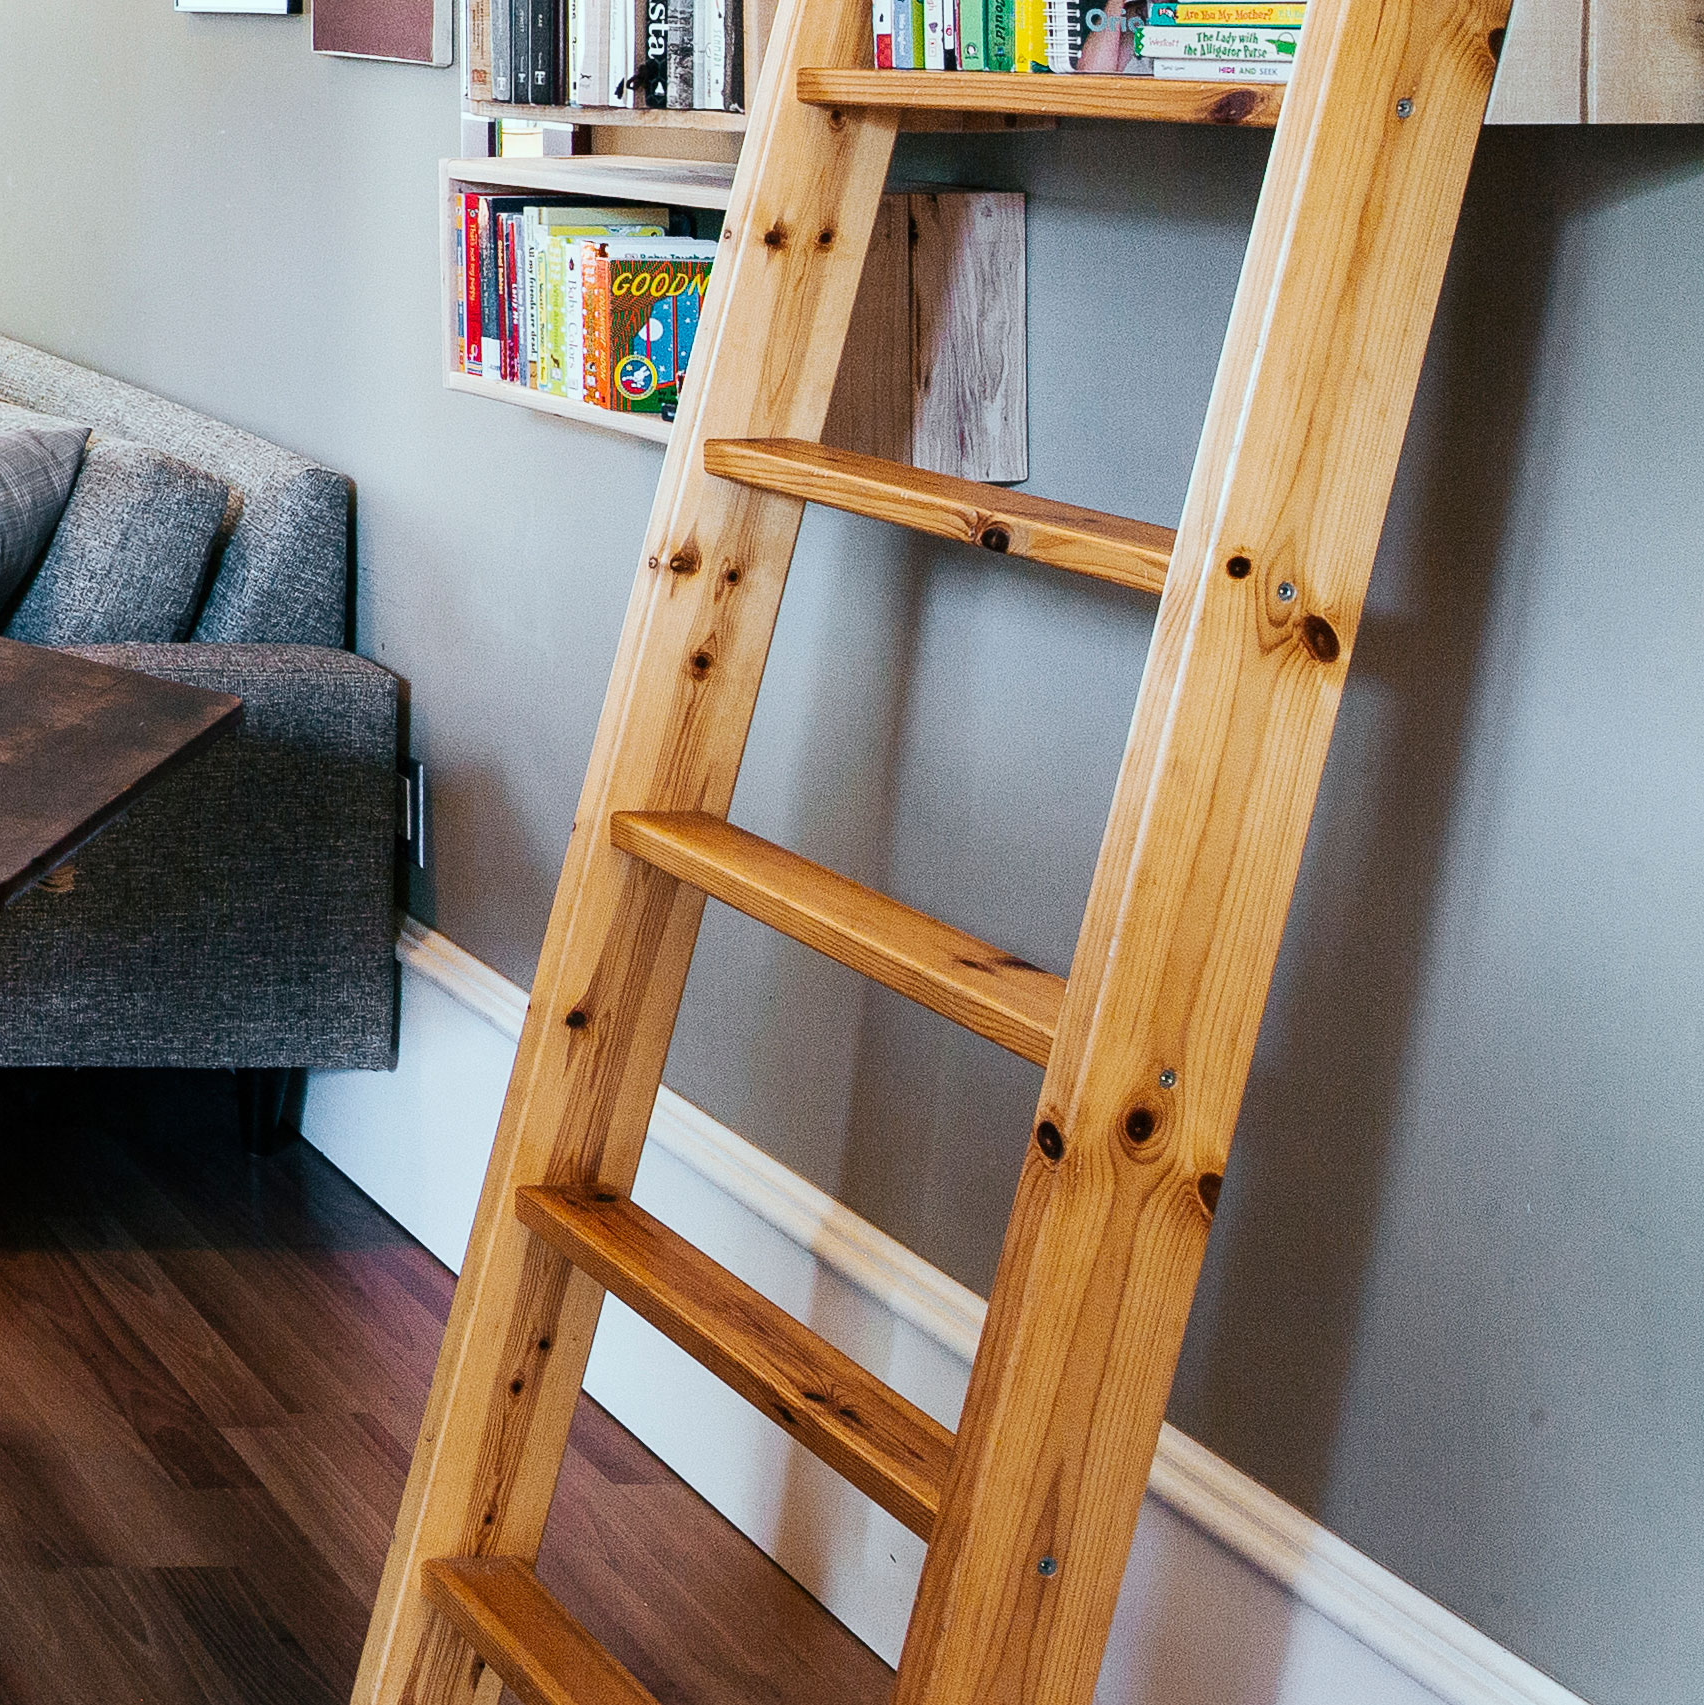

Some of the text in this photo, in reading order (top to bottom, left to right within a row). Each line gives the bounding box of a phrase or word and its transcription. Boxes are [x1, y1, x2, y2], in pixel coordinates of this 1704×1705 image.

[1184, 8, 1274, 23] Are You My Mother?
[1197, 31, 1259, 45] The Lady with
[1184, 44, 1267, 58] the Alligator Purse
[1219, 66, 1235, 74] HIDE
[469, 223, 478, 246] That's
[528, 245, 537, 258] All
[527, 260, 536, 274] my
[612, 273, 710, 297] GOODN
[529, 277, 538, 310] friends
[566, 280, 578, 369] Baby Colors
[530, 331, 538, 356] dead.
